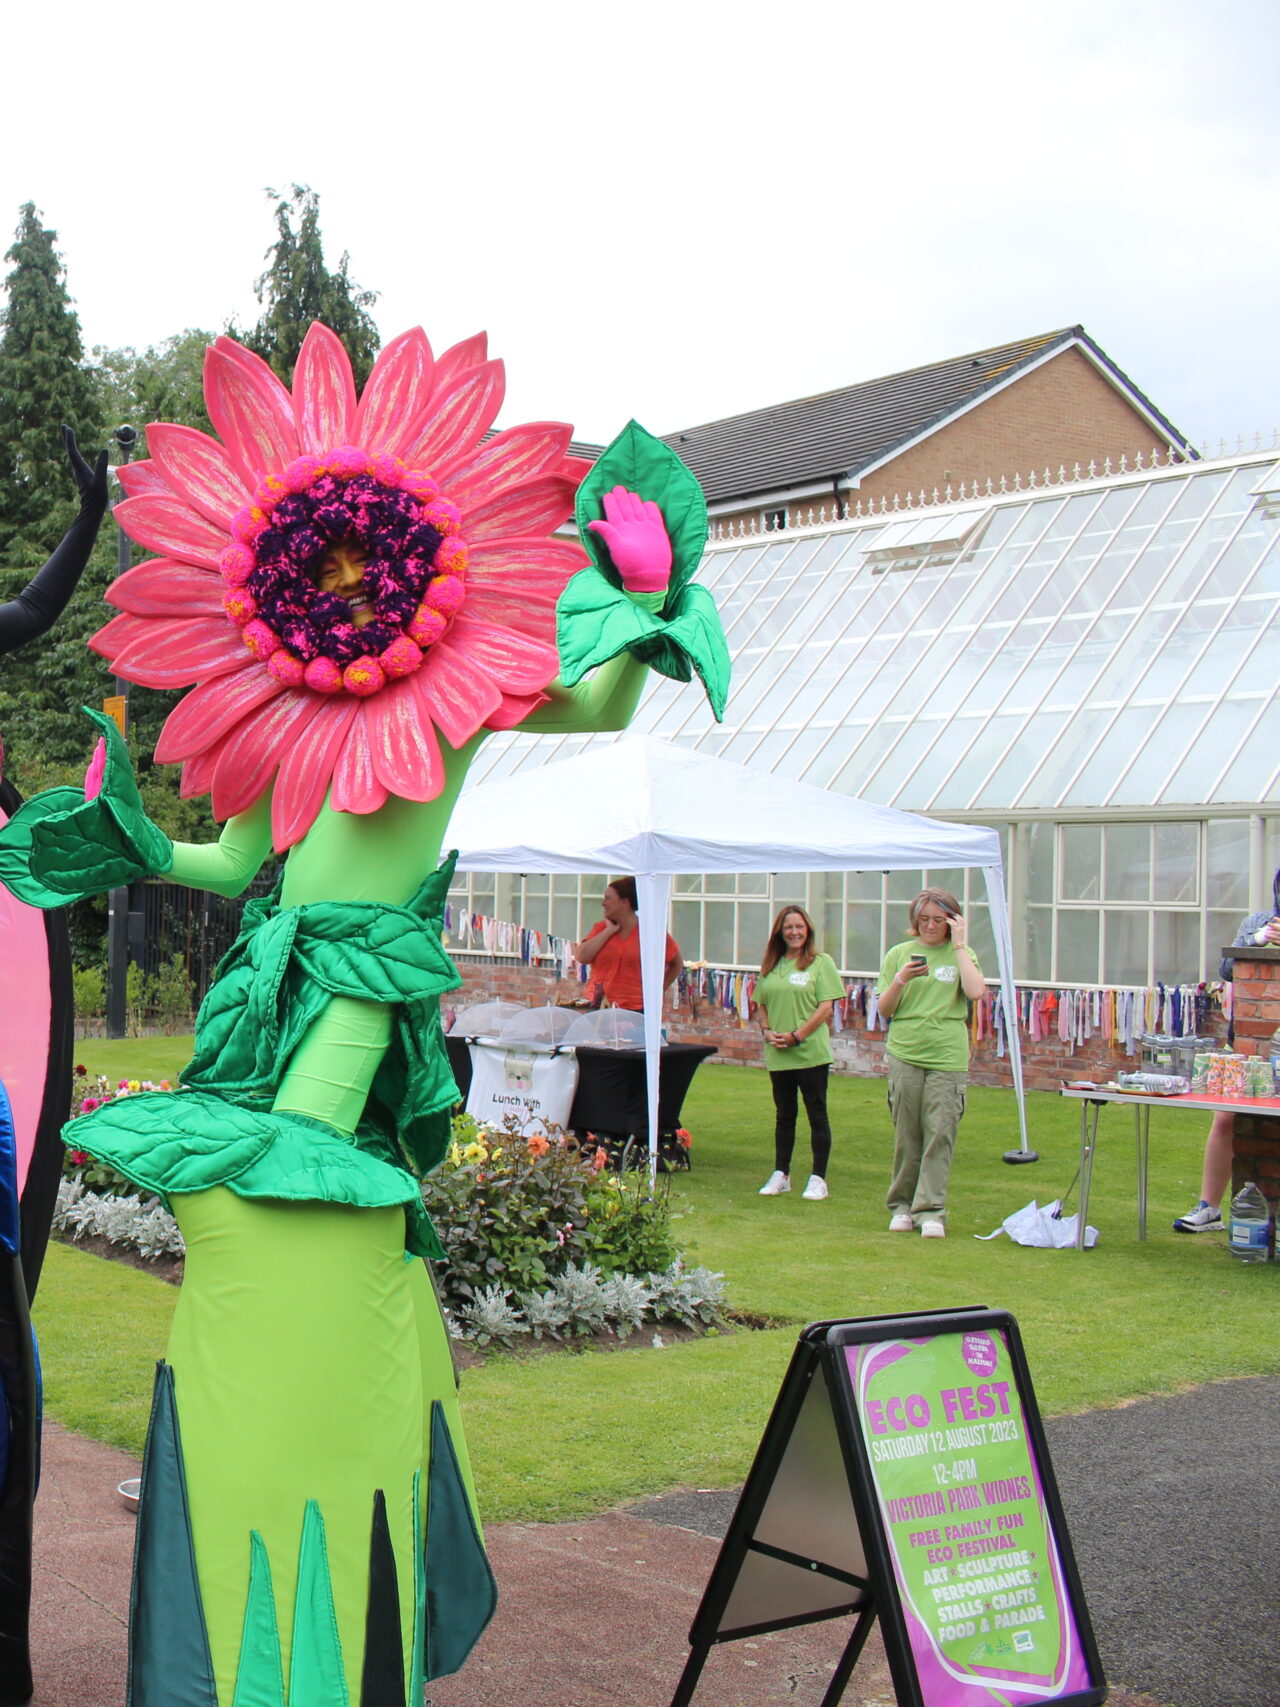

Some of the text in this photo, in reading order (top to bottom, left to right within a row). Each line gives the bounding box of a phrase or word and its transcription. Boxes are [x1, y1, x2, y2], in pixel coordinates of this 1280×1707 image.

[492, 1093, 521, 1106] Lunch
[865, 1381, 1011, 1435] ECO FEST
[872, 1419, 1019, 1462] SATURDAY 12 AUGUST 2023
[932, 1458, 978, 1485] 12-4PM
[885, 1475, 1032, 1524] VICTORIA PARK WIDNES
[909, 1513, 1023, 1547] FREE FAMILY FUN
[928, 1534, 1015, 1563] ECO FESTIVAL
[924, 1551, 1030, 1585] ART SCULPTURE
[932, 1570, 1031, 1603] PERFORMANCE
[938, 1588, 1036, 1622] STALLS CRAFTS
[938, 1606, 1045, 1643] FOOD & PARADE
